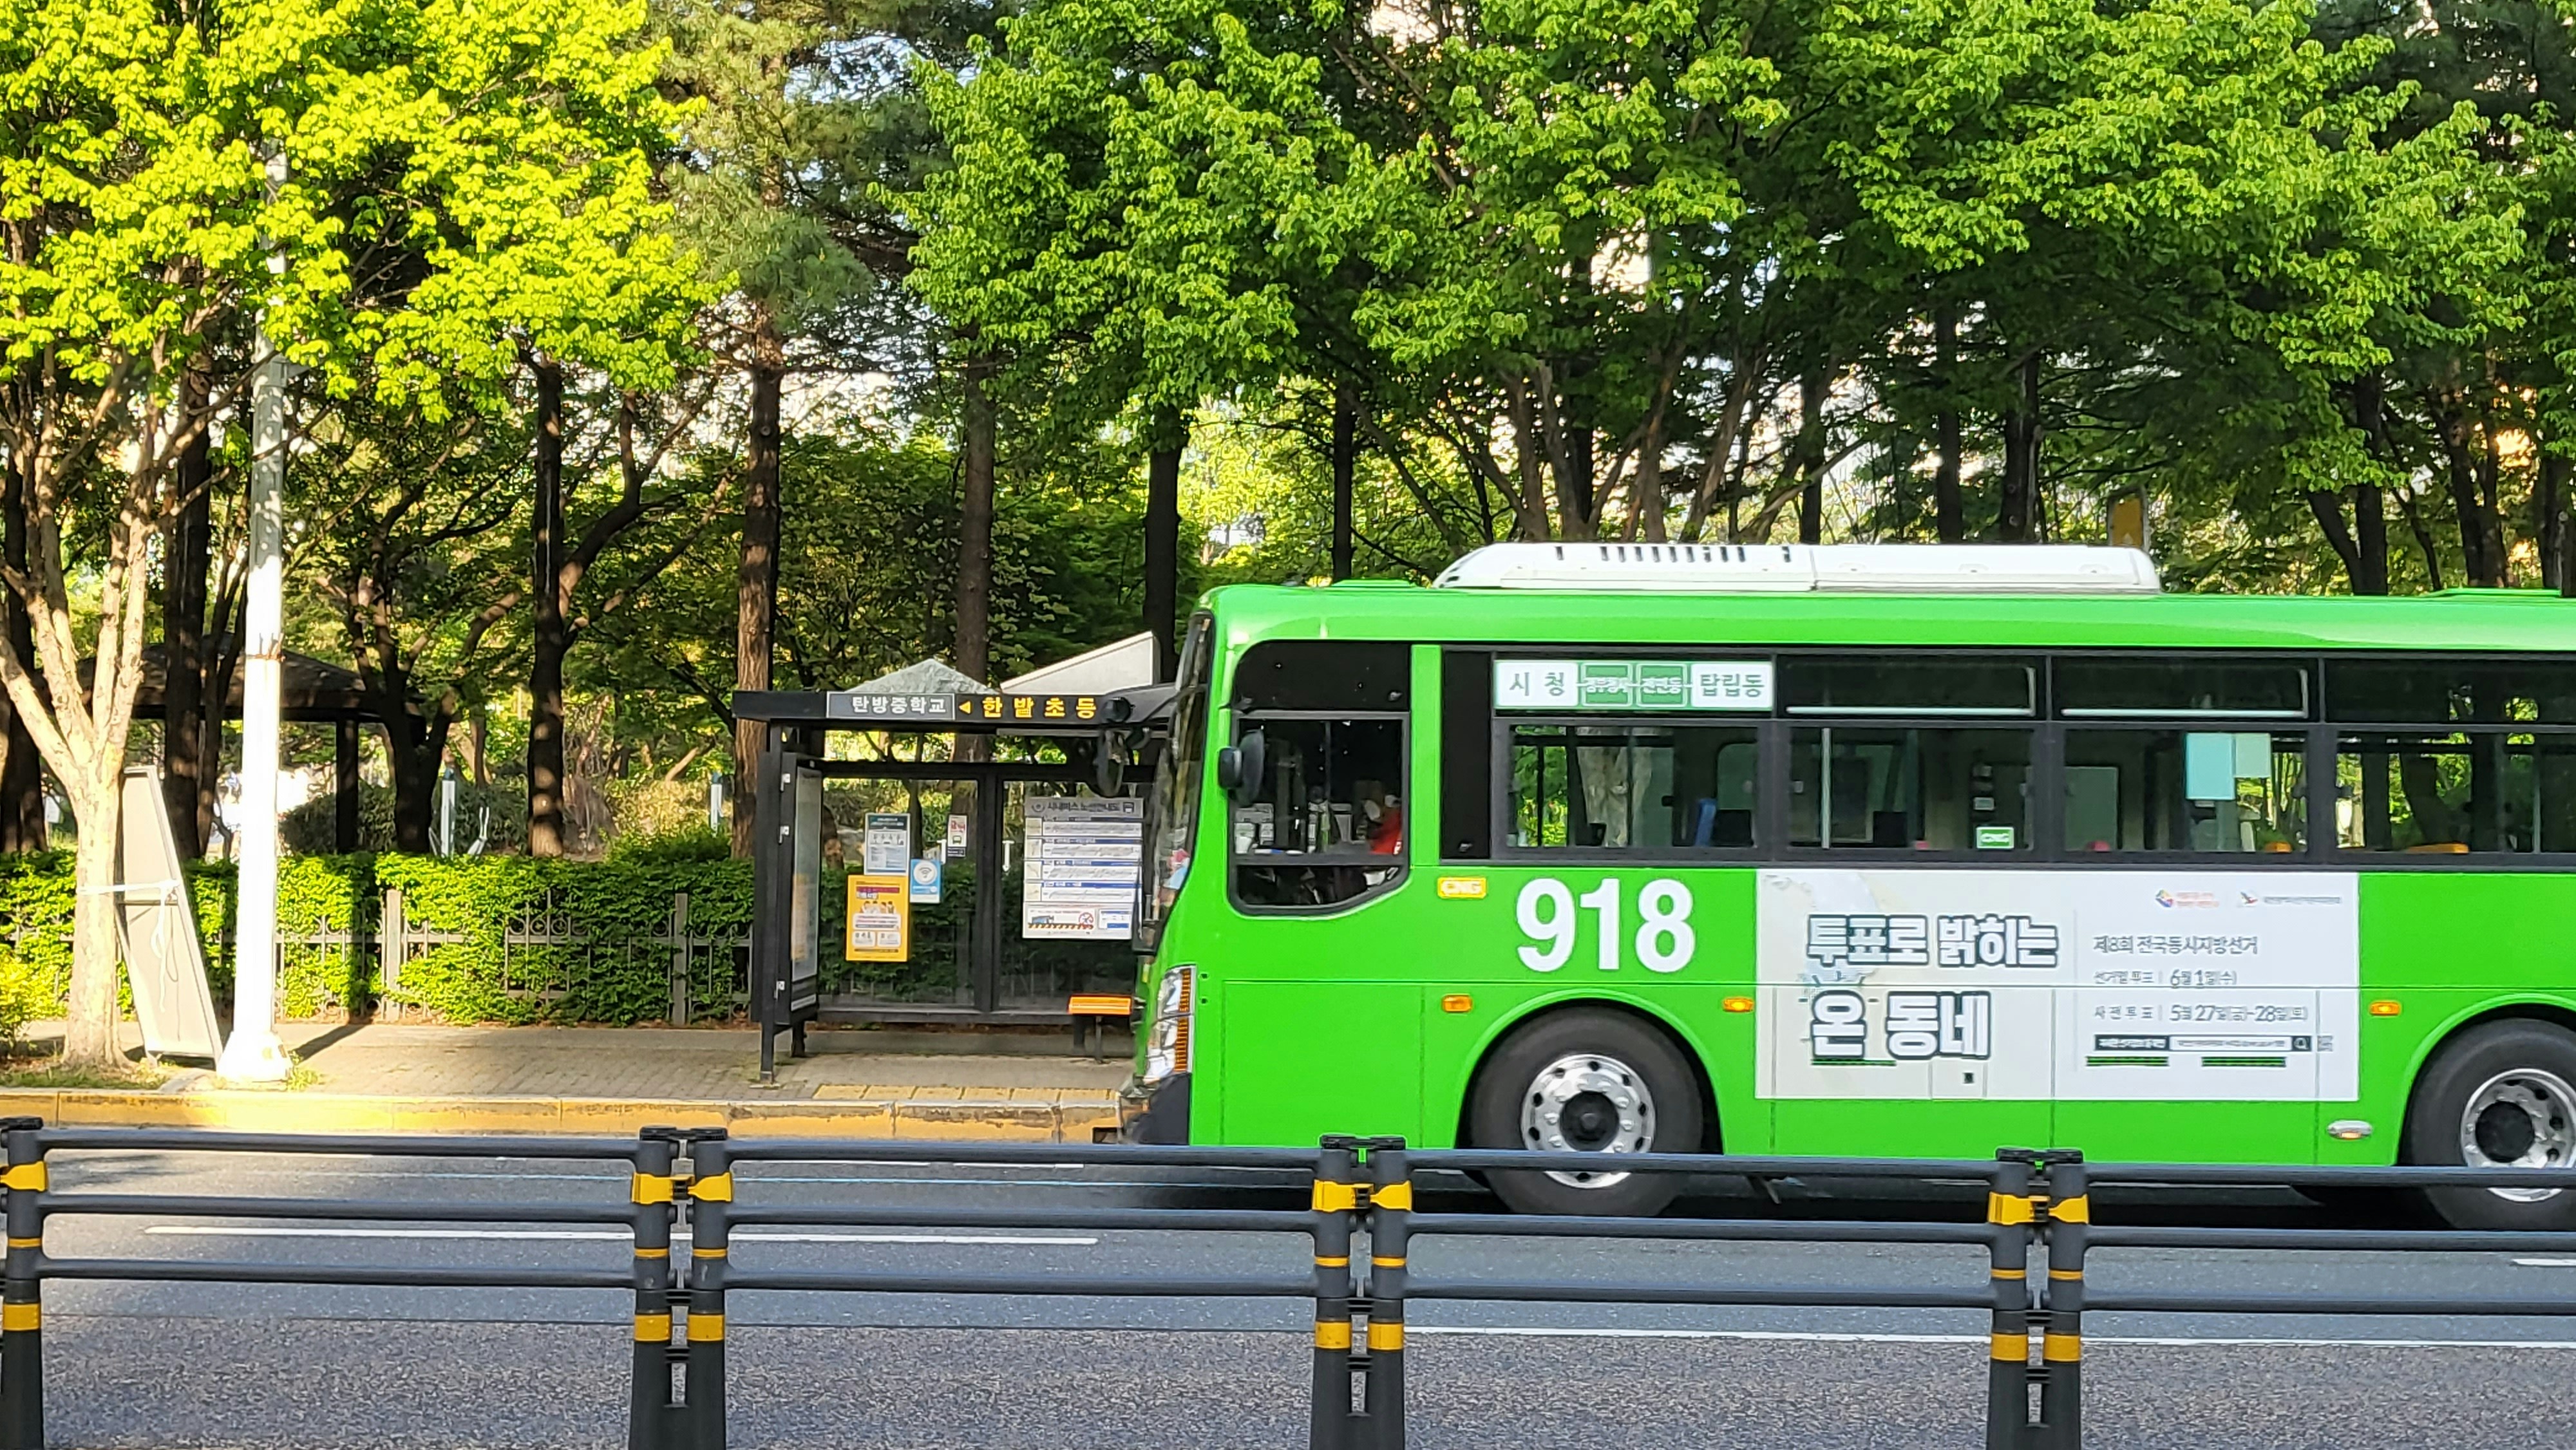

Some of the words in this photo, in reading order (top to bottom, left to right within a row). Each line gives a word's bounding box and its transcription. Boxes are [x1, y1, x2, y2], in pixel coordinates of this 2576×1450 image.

[1700, 673, 1765, 697] 탑립동
[851, 695, 946, 715] 탄방중학교
[1516, 878, 1696, 973] 918
[1807, 914, 1929, 966] 투표로
[1937, 914, 2059, 968] 밝히는
[2093, 935, 2134, 955] 제8회
[2137, 935, 2259, 956] 전국동시지방선거
[1810, 990, 1867, 1059] 온
[1886, 990, 1991, 1060] 동네
